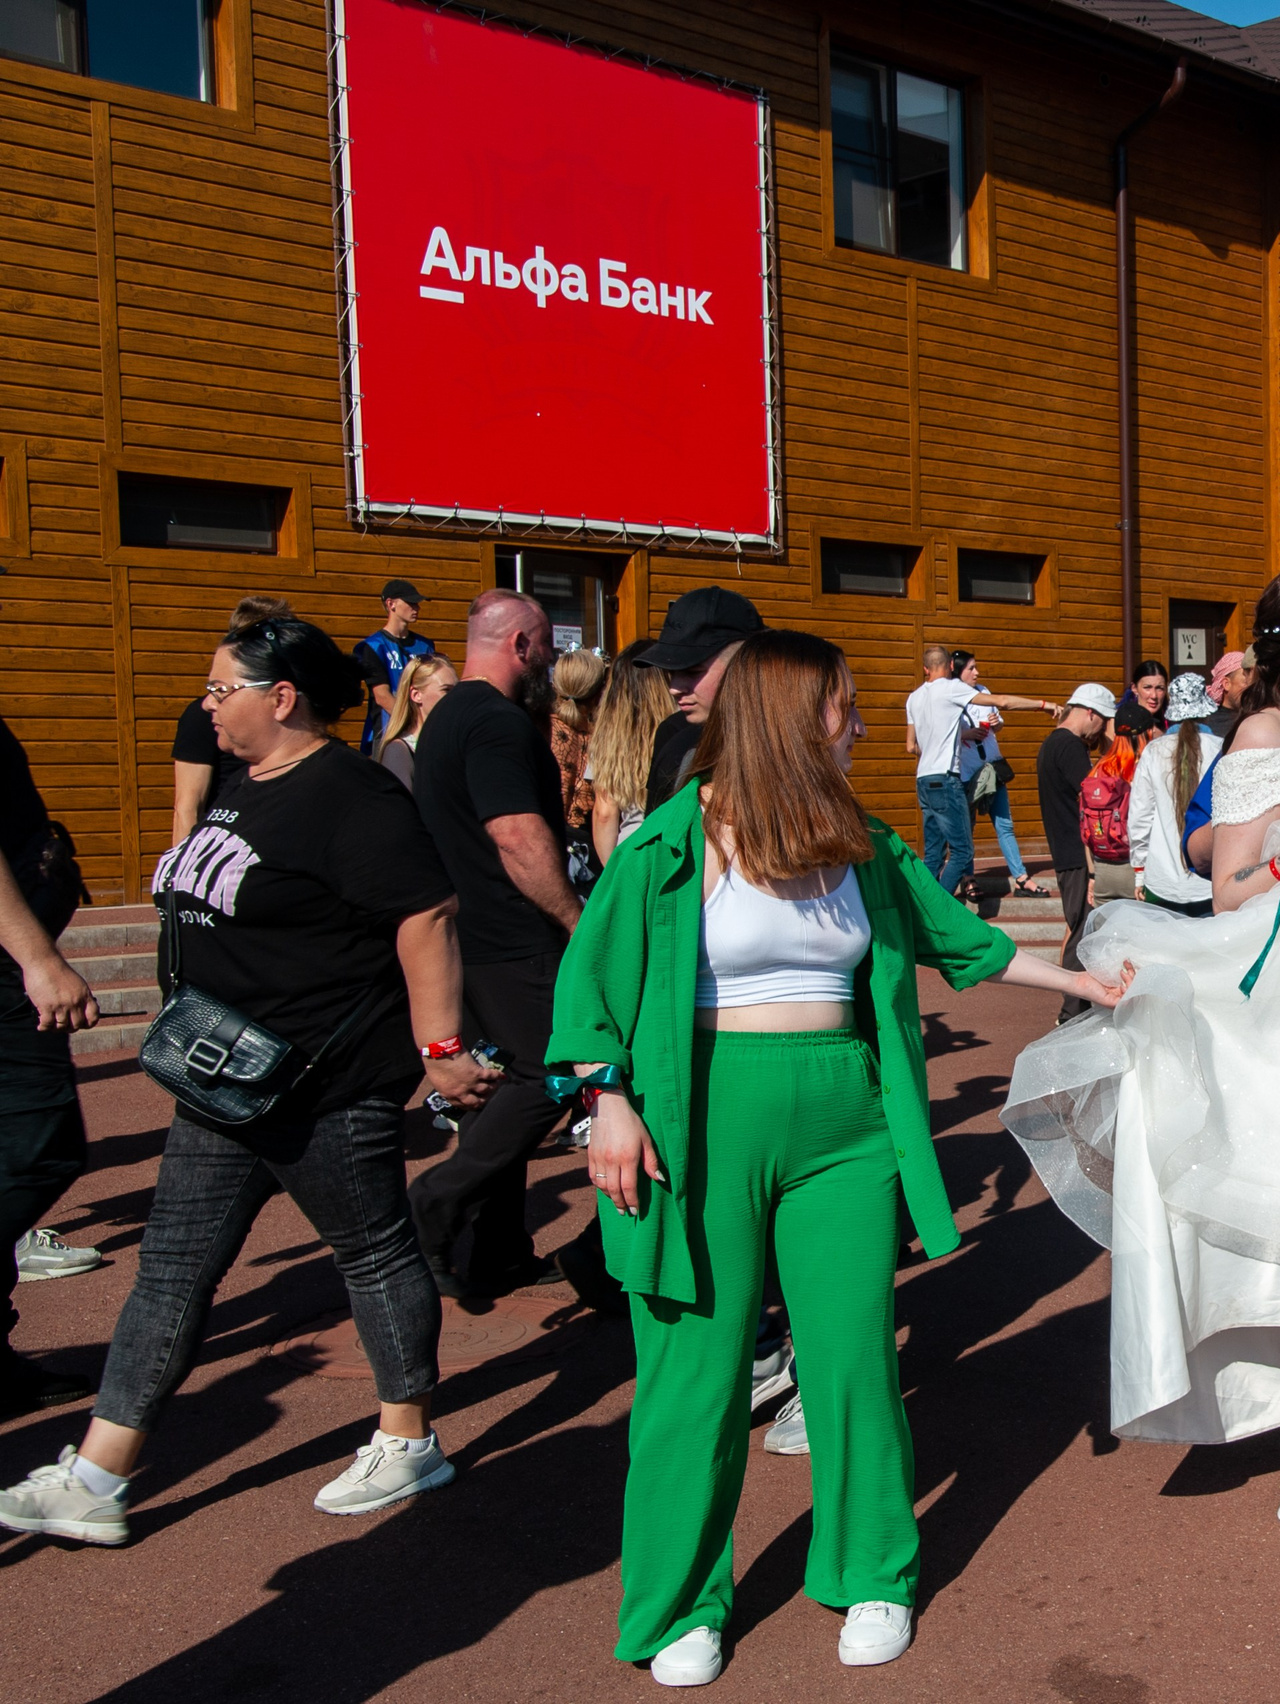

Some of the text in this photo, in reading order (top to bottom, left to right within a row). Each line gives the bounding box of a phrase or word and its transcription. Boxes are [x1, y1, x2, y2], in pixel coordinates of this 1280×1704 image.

[420, 226, 715, 325] Альфа Банк
[1182, 633, 1197, 644] WC
